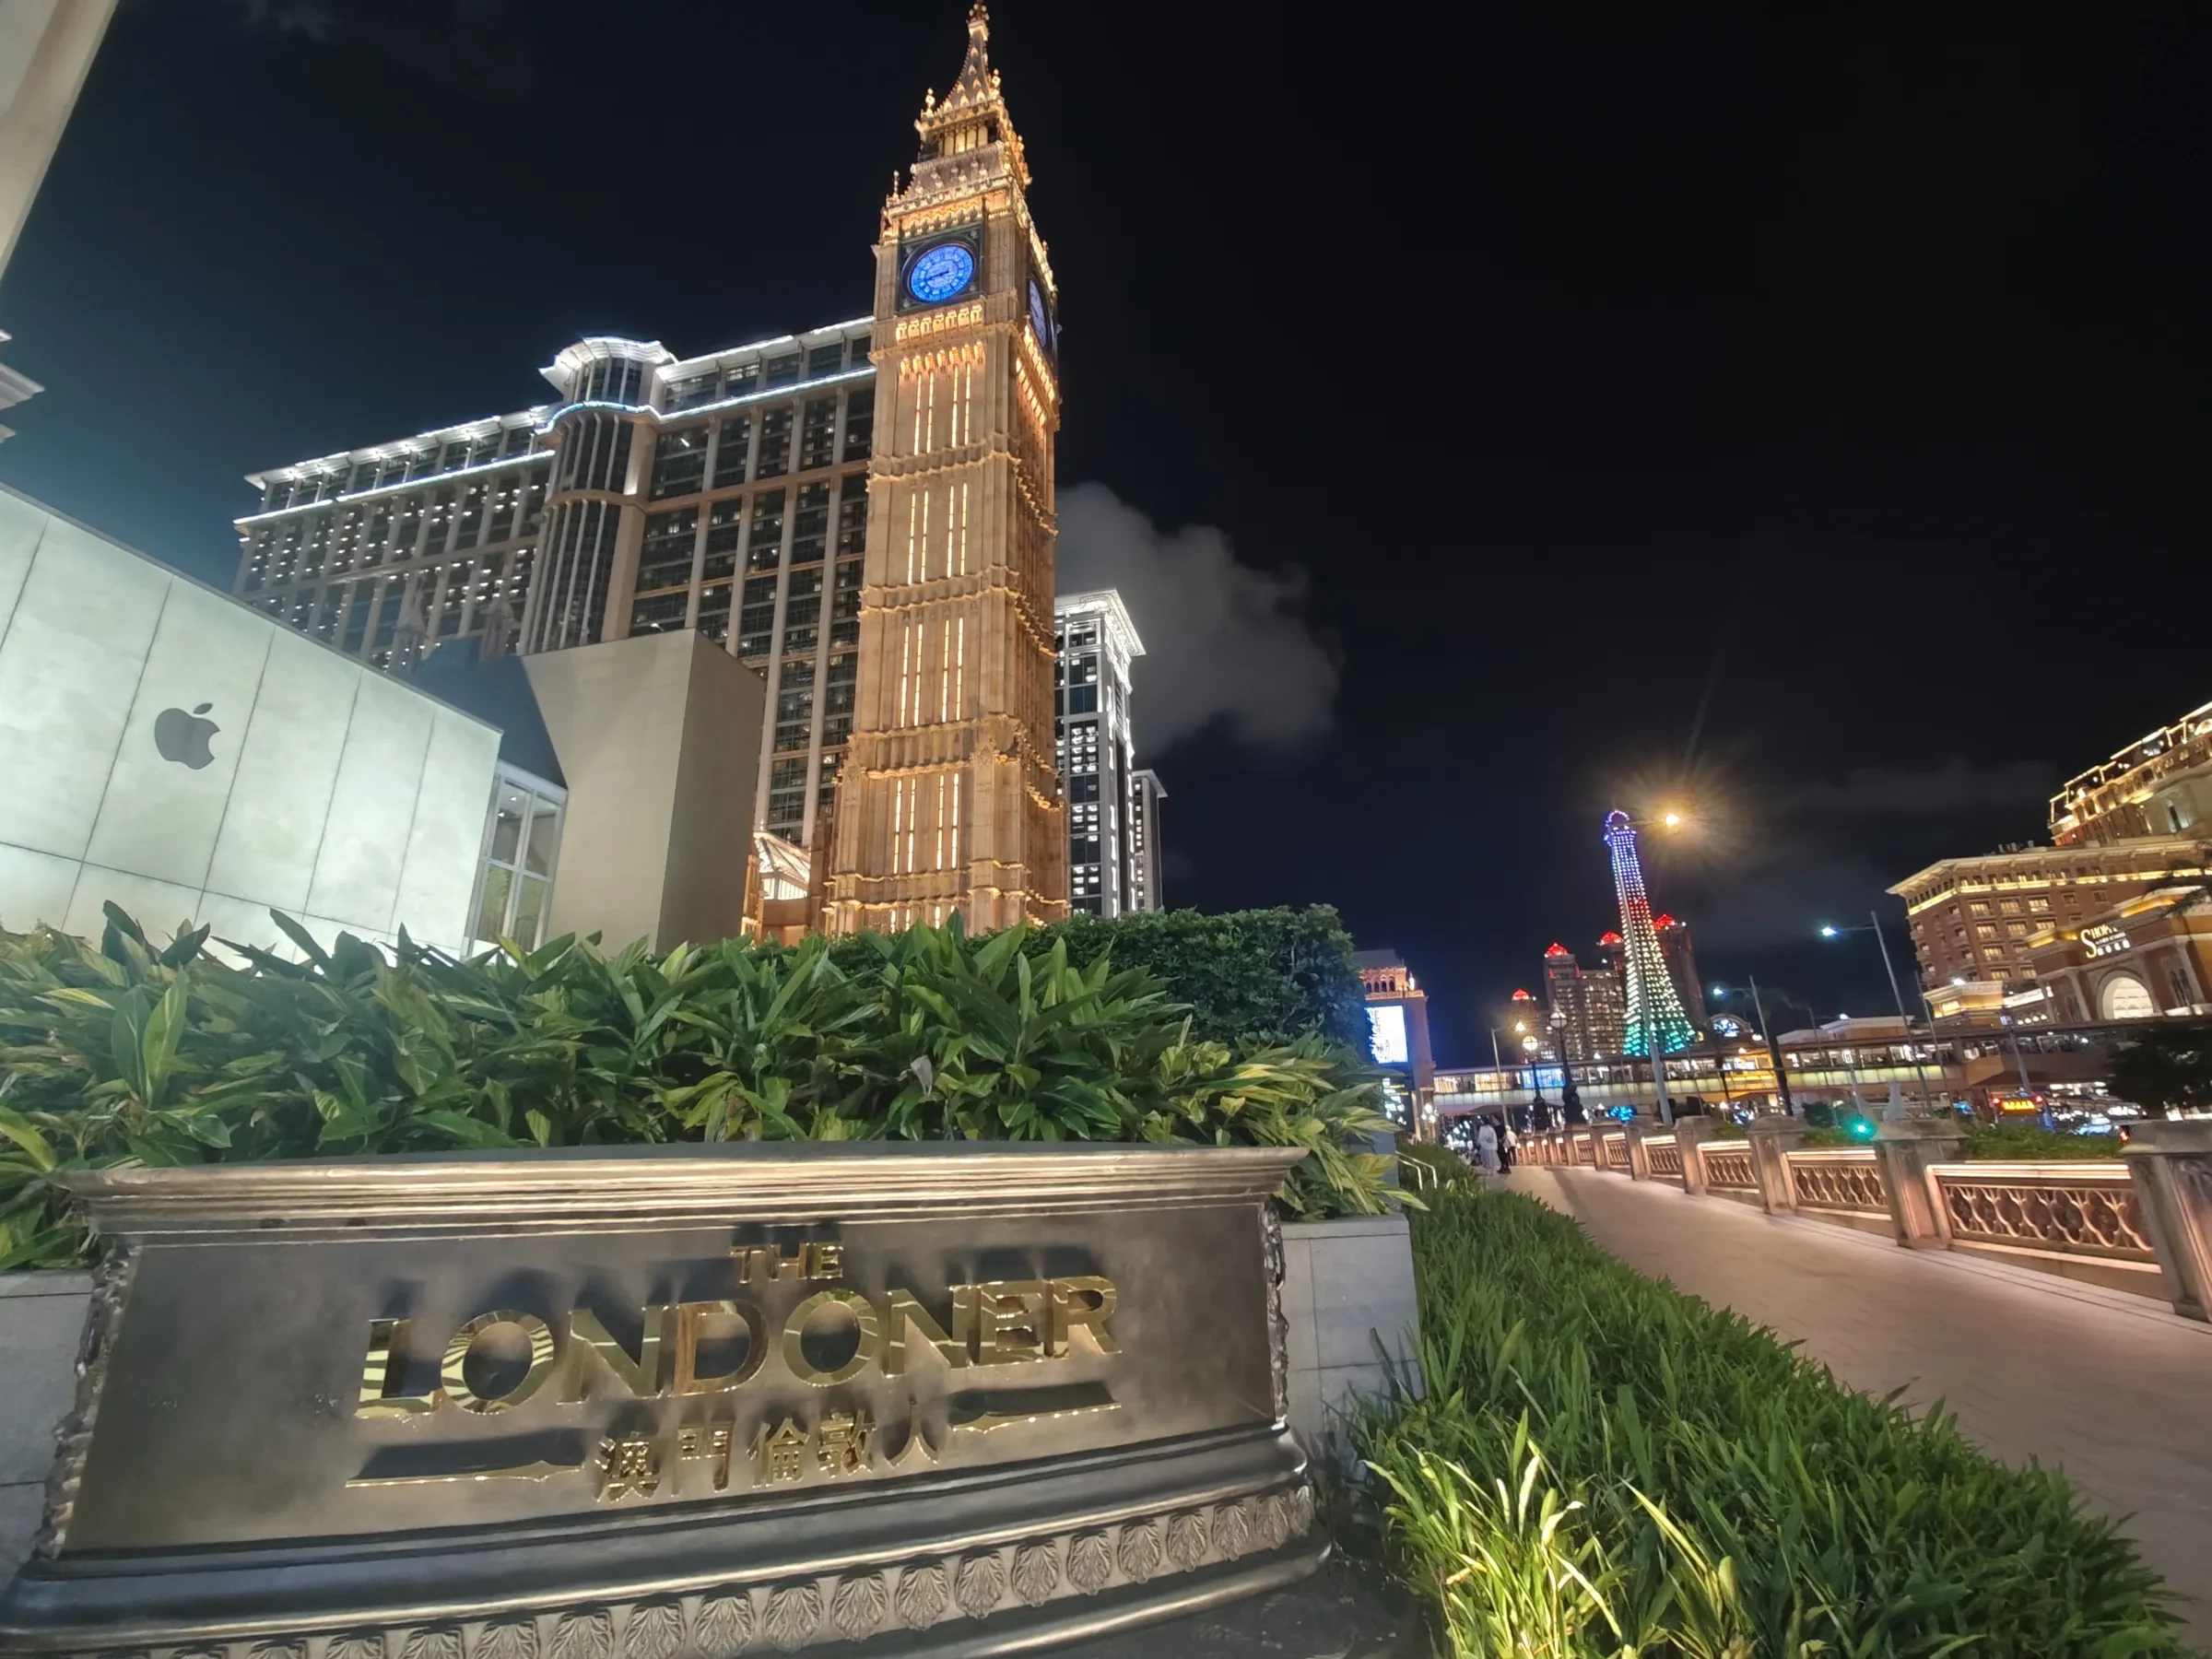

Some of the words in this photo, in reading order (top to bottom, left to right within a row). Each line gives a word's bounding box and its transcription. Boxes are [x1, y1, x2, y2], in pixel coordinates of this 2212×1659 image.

[729, 1242, 844, 1284] THE
[355, 1276, 1122, 1420] LONDONER
[593, 1397, 939, 1503] 澳門倫敦人
